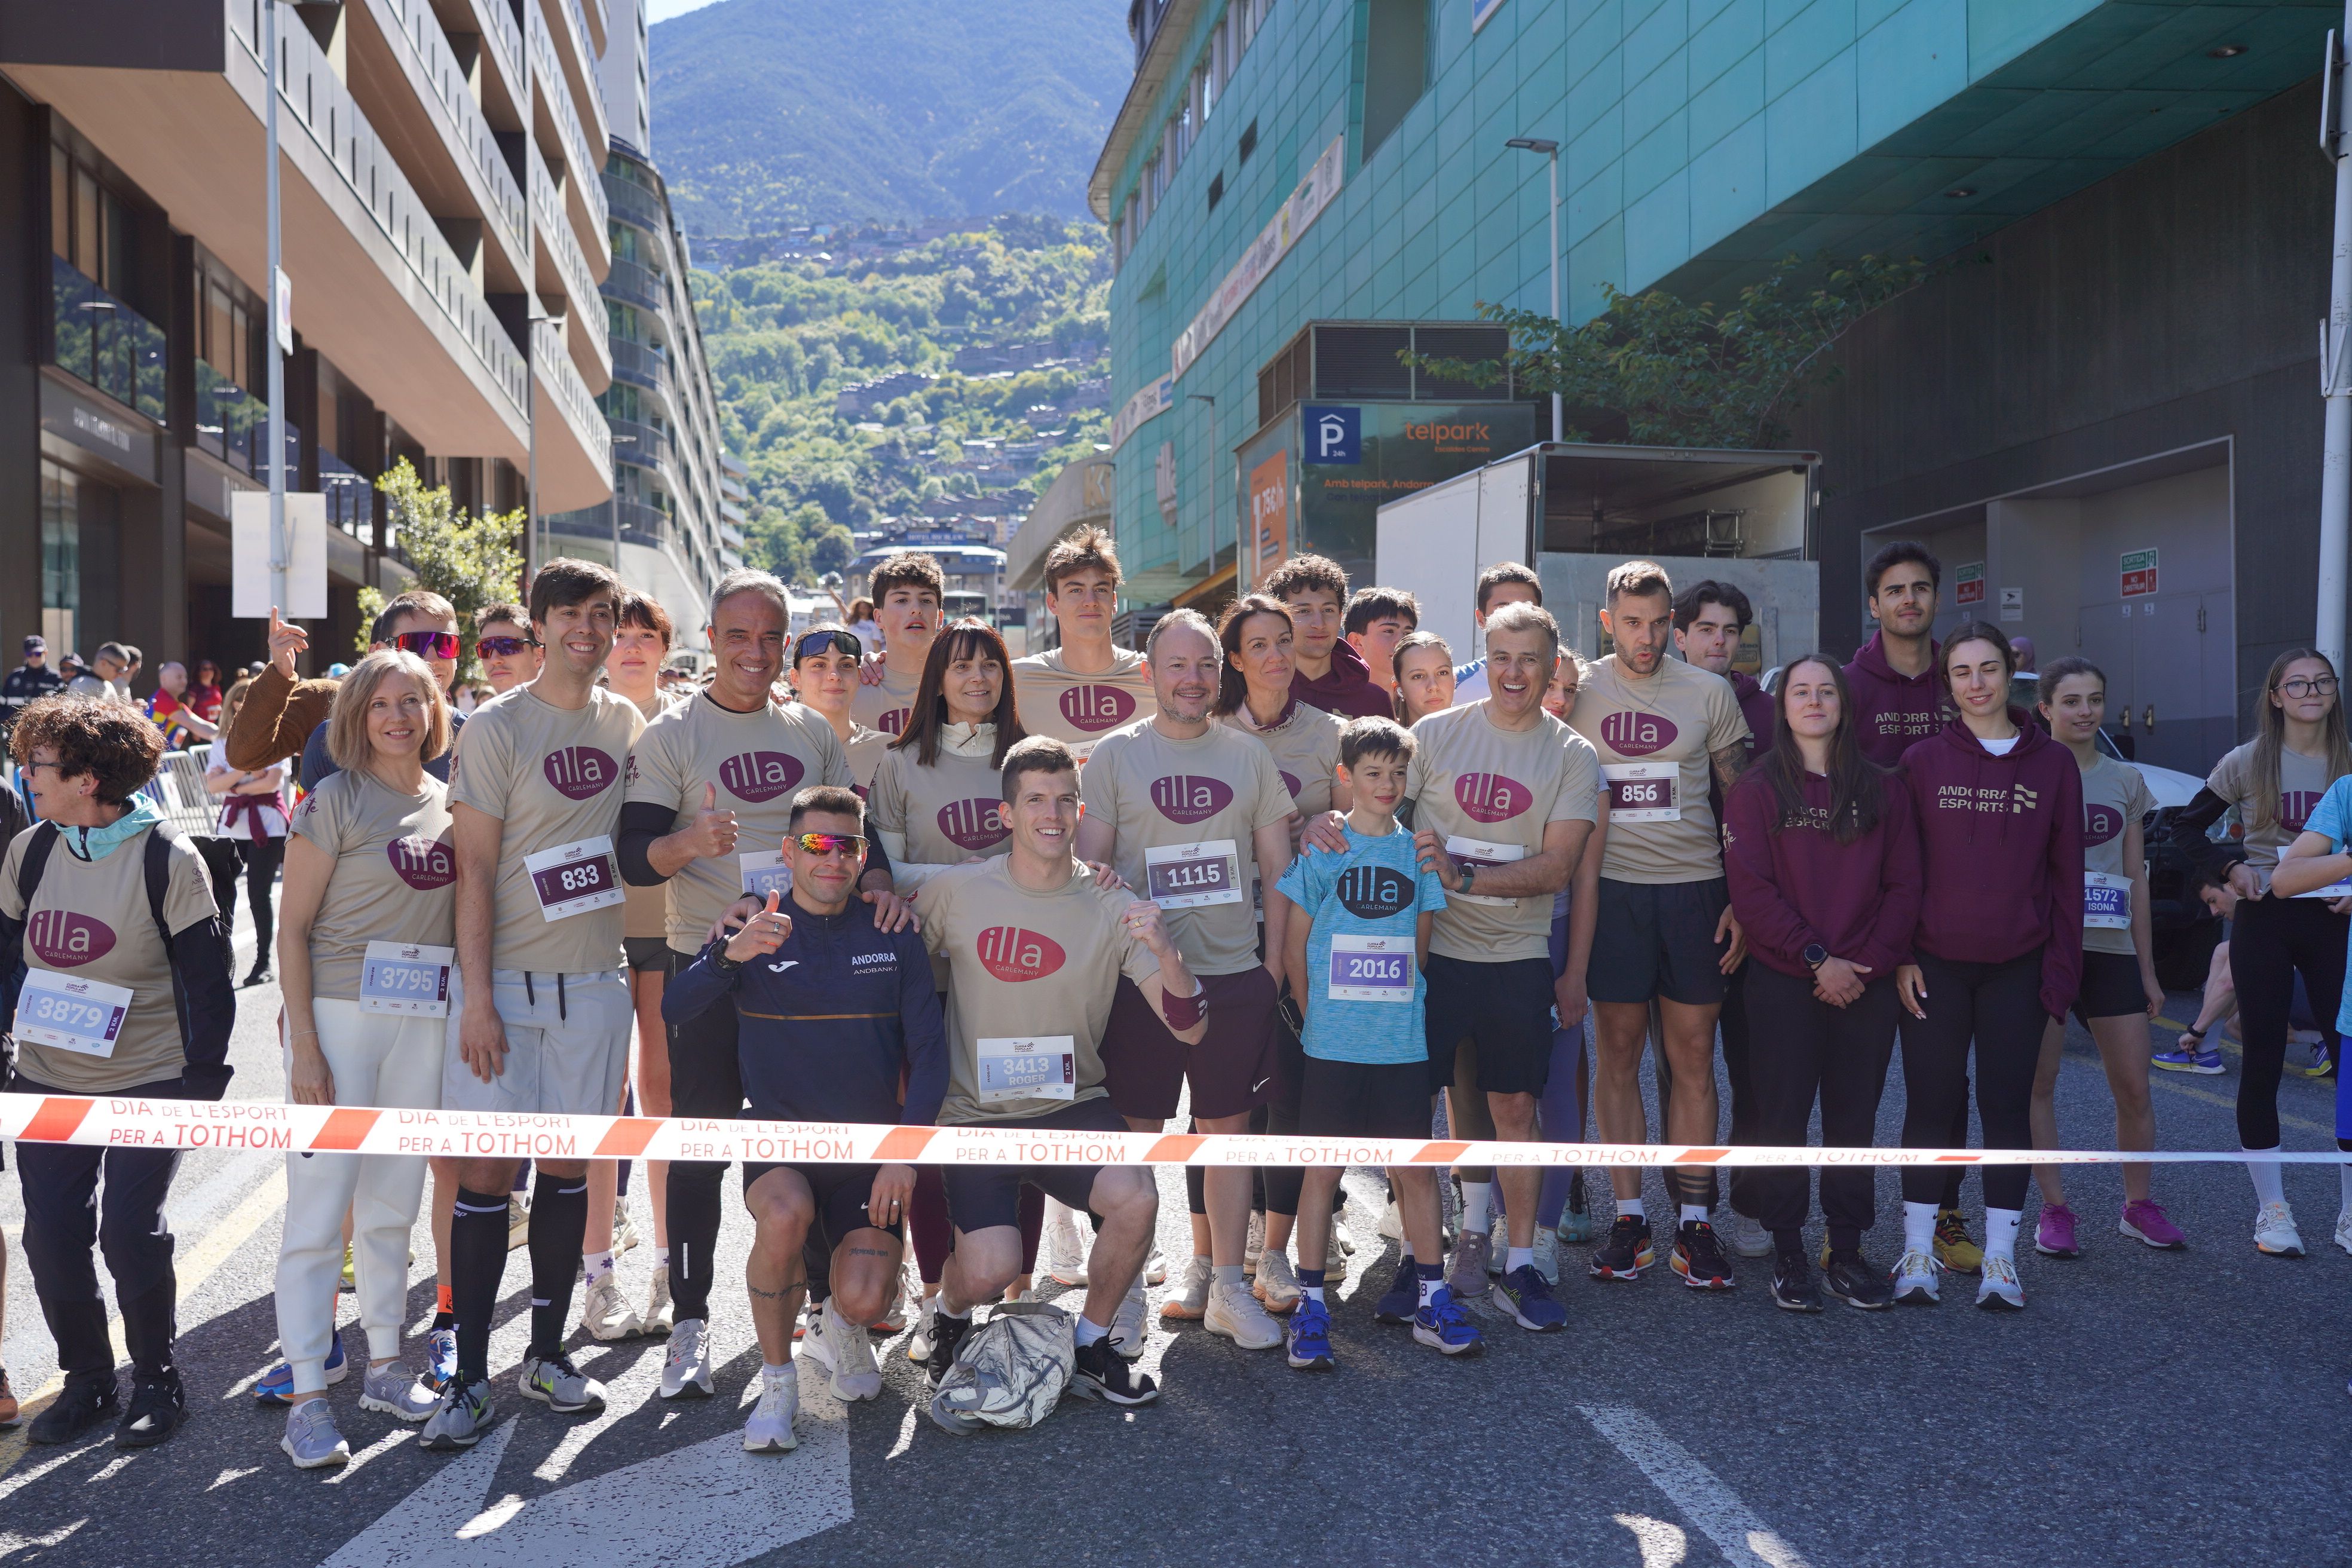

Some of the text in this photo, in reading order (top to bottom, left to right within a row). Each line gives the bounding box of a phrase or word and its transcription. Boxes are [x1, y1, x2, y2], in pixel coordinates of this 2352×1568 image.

[1320, 423, 1345, 457] P
[1405, 421, 1490, 445] telpark
[1324, 479, 1349, 488] Amb
[1351, 479, 1391, 491] telpark,
[1068, 685, 1118, 717] illa
[1609, 711, 1658, 743] illa
[551, 746, 602, 784] illa
[727, 752, 786, 788] illa
[568, 782, 604, 792] CARLEMANY
[745, 784, 788, 795] CARLEMANY
[1159, 776, 1212, 807] illa
[1462, 772, 1512, 810] illa
[1622, 784, 1658, 802] 856
[1937, 785, 2010, 801] ANDORRA
[1472, 807, 1508, 818] CARLEMANY
[1938, 798, 2008, 813] ESPORTS
[946, 798, 1002, 836] illa
[397, 837, 449, 874] illa
[411, 873, 449, 883] CARLEMANY
[561, 864, 600, 890] 833
[1167, 863, 1221, 887] 1115
[1345, 866, 1398, 904] illa
[2084, 888, 2118, 902] 1572
[1356, 904, 1398, 912] CARLEMANY
[2088, 903, 2115, 911] ISONA
[35, 909, 90, 953] illa
[44, 950, 89, 961] CARLEMANY
[985, 927, 1043, 969] illa
[852, 953, 897, 966] ANDORRA
[1349, 958, 1401, 979] 2016
[853, 966, 893, 975] ANDBANK
[995, 964, 1039, 976] CARLEMANY
[381, 967, 434, 992] 3795
[37, 997, 103, 1028] 3879
[111, 1015, 120, 1026] KM.
[1003, 1057, 1049, 1075] 3413
[1009, 1074, 1046, 1086] ROGER
[110, 1100, 288, 1121] DIA DE L'ESPORT
[399, 1111, 572, 1129] DIA DE L'ESPORT
[681, 1122, 720, 1132] DIA
[109, 1124, 292, 1148] PER A TOTHOM
[399, 1132, 575, 1155] PER A TOTHOM
[681, 1138, 853, 1159] PER A TOTHOM
[957, 1144, 1125, 1162] PER A TOTHOM
[1226, 1147, 1393, 1163] PER A TOTHOM
[1492, 1154, 1524, 1163] PER
[1551, 1149, 1658, 1163] TOTHOM
